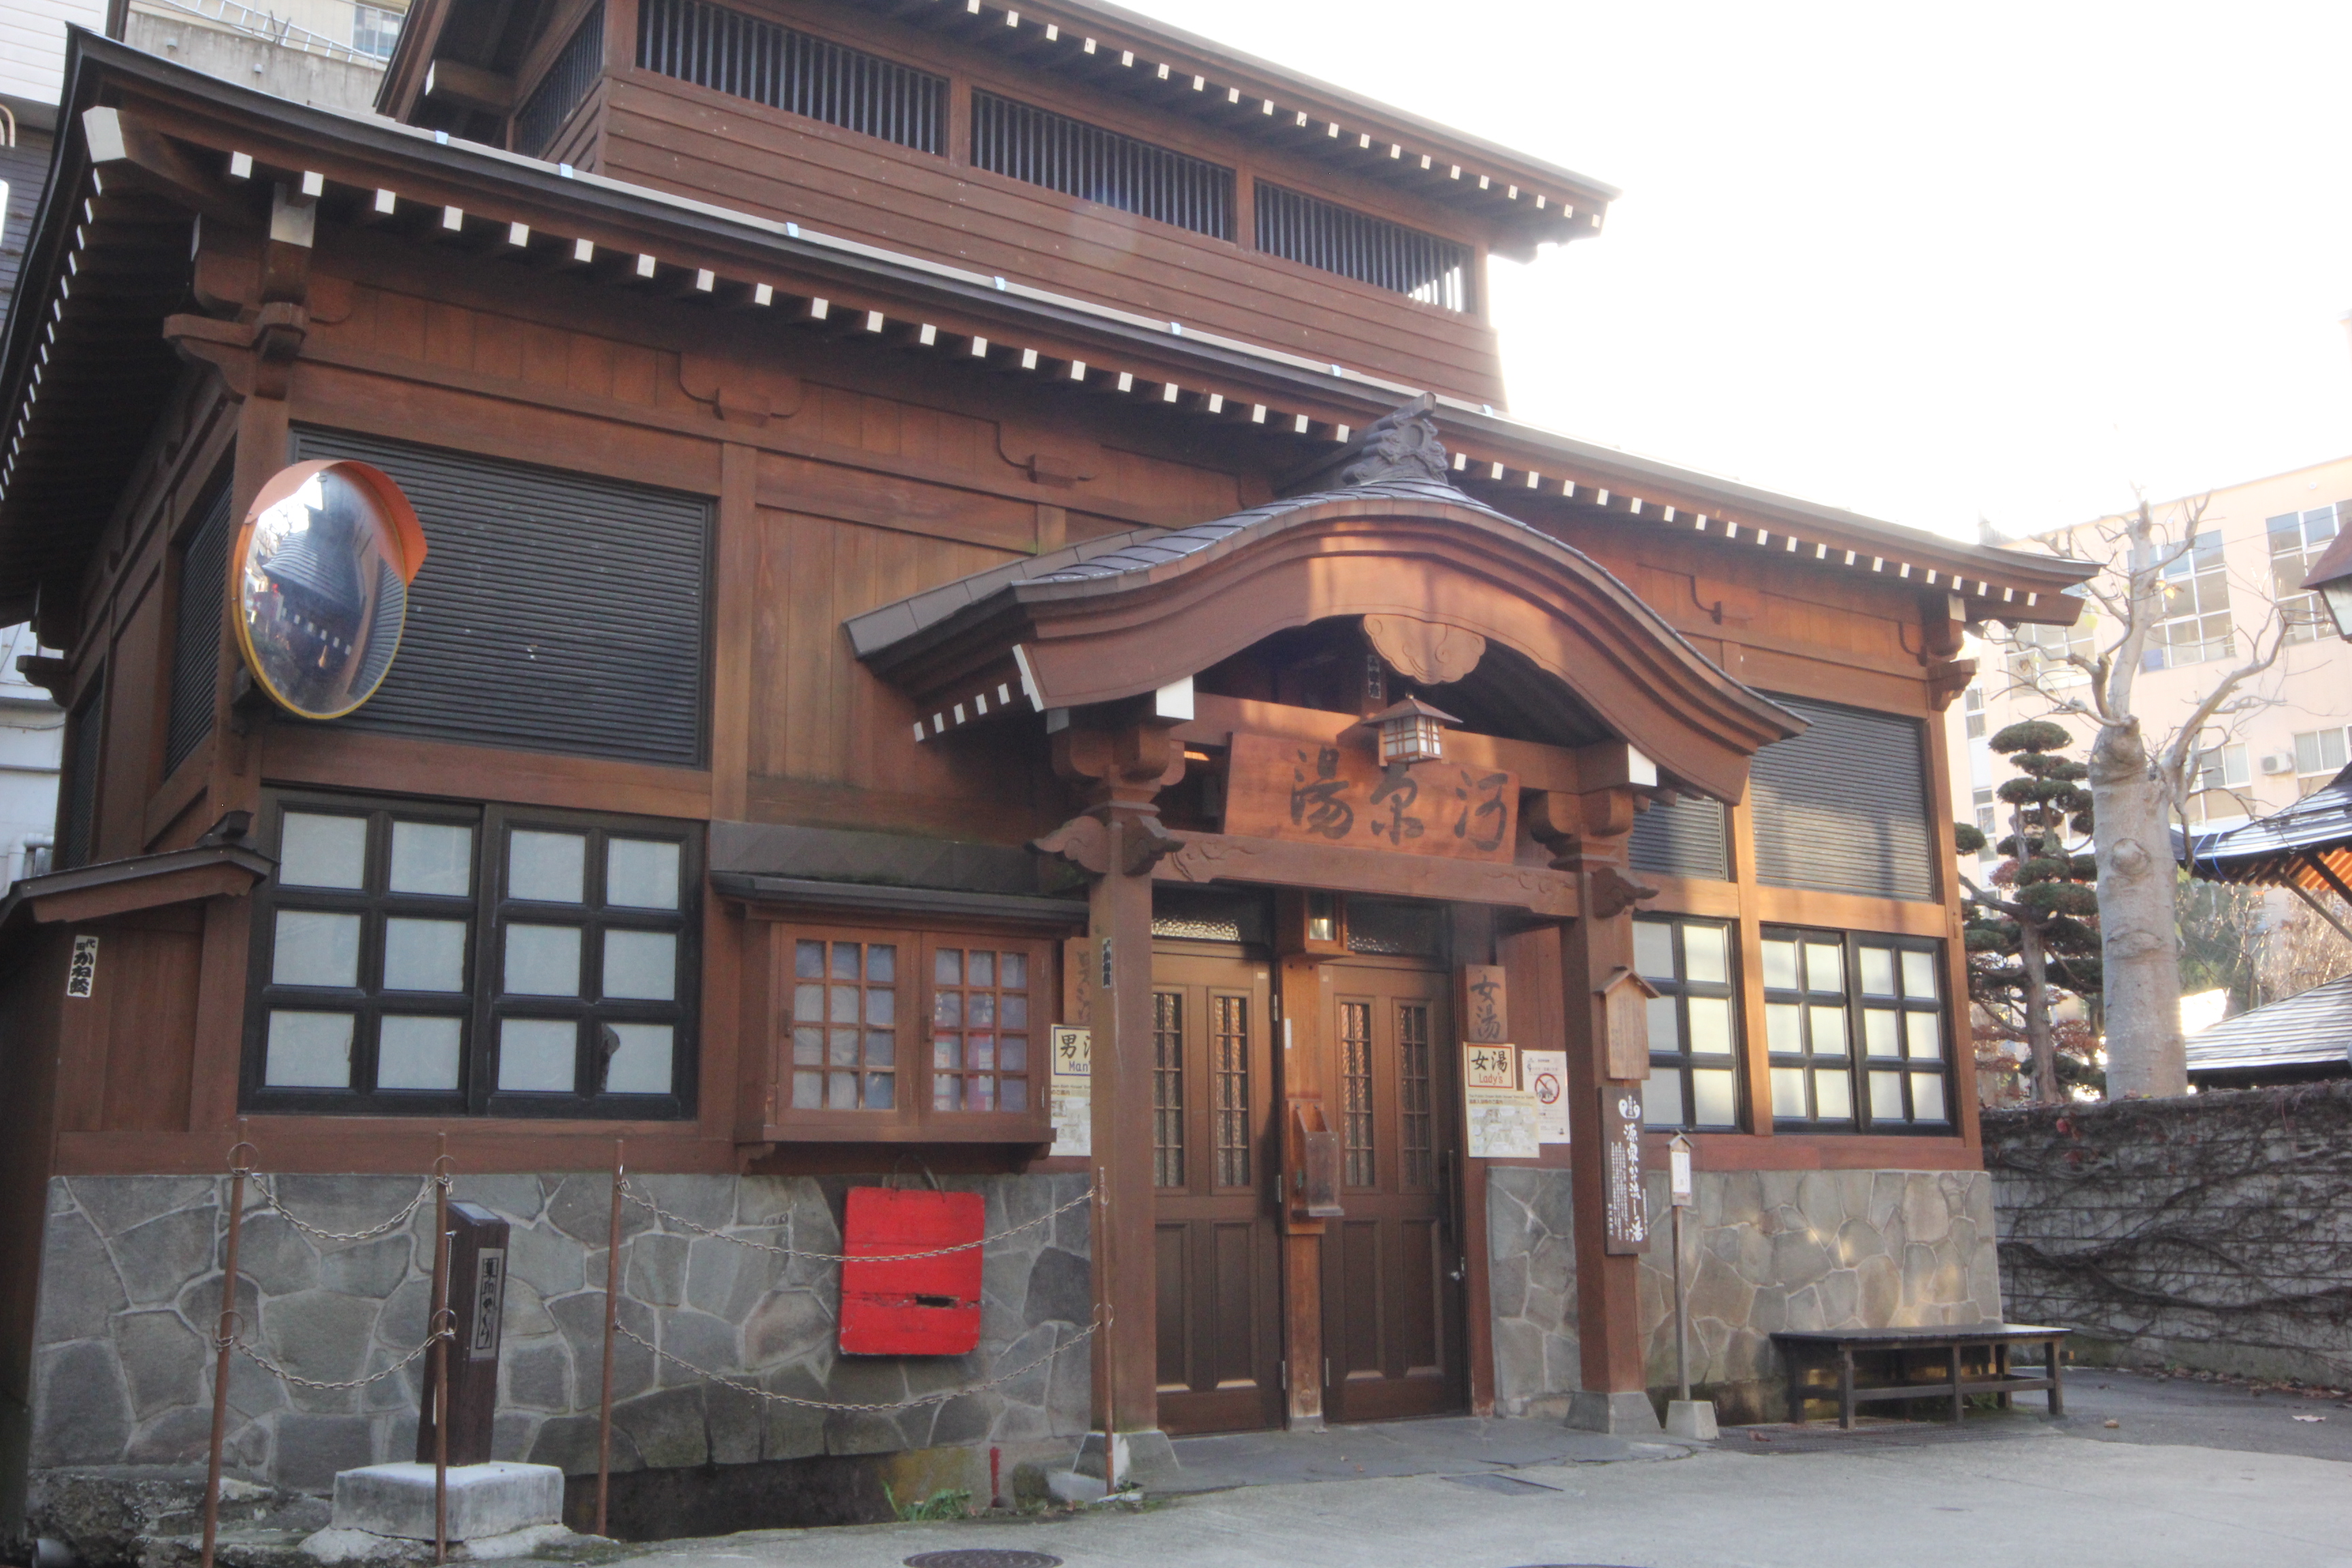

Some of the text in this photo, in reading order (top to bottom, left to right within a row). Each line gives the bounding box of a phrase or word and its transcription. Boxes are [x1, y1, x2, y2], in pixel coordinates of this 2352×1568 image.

[1469, 975, 1501, 1040] 女湯
[1471, 1050, 1508, 1073] 女湯
[1479, 1072, 1503, 1085] Lady's
